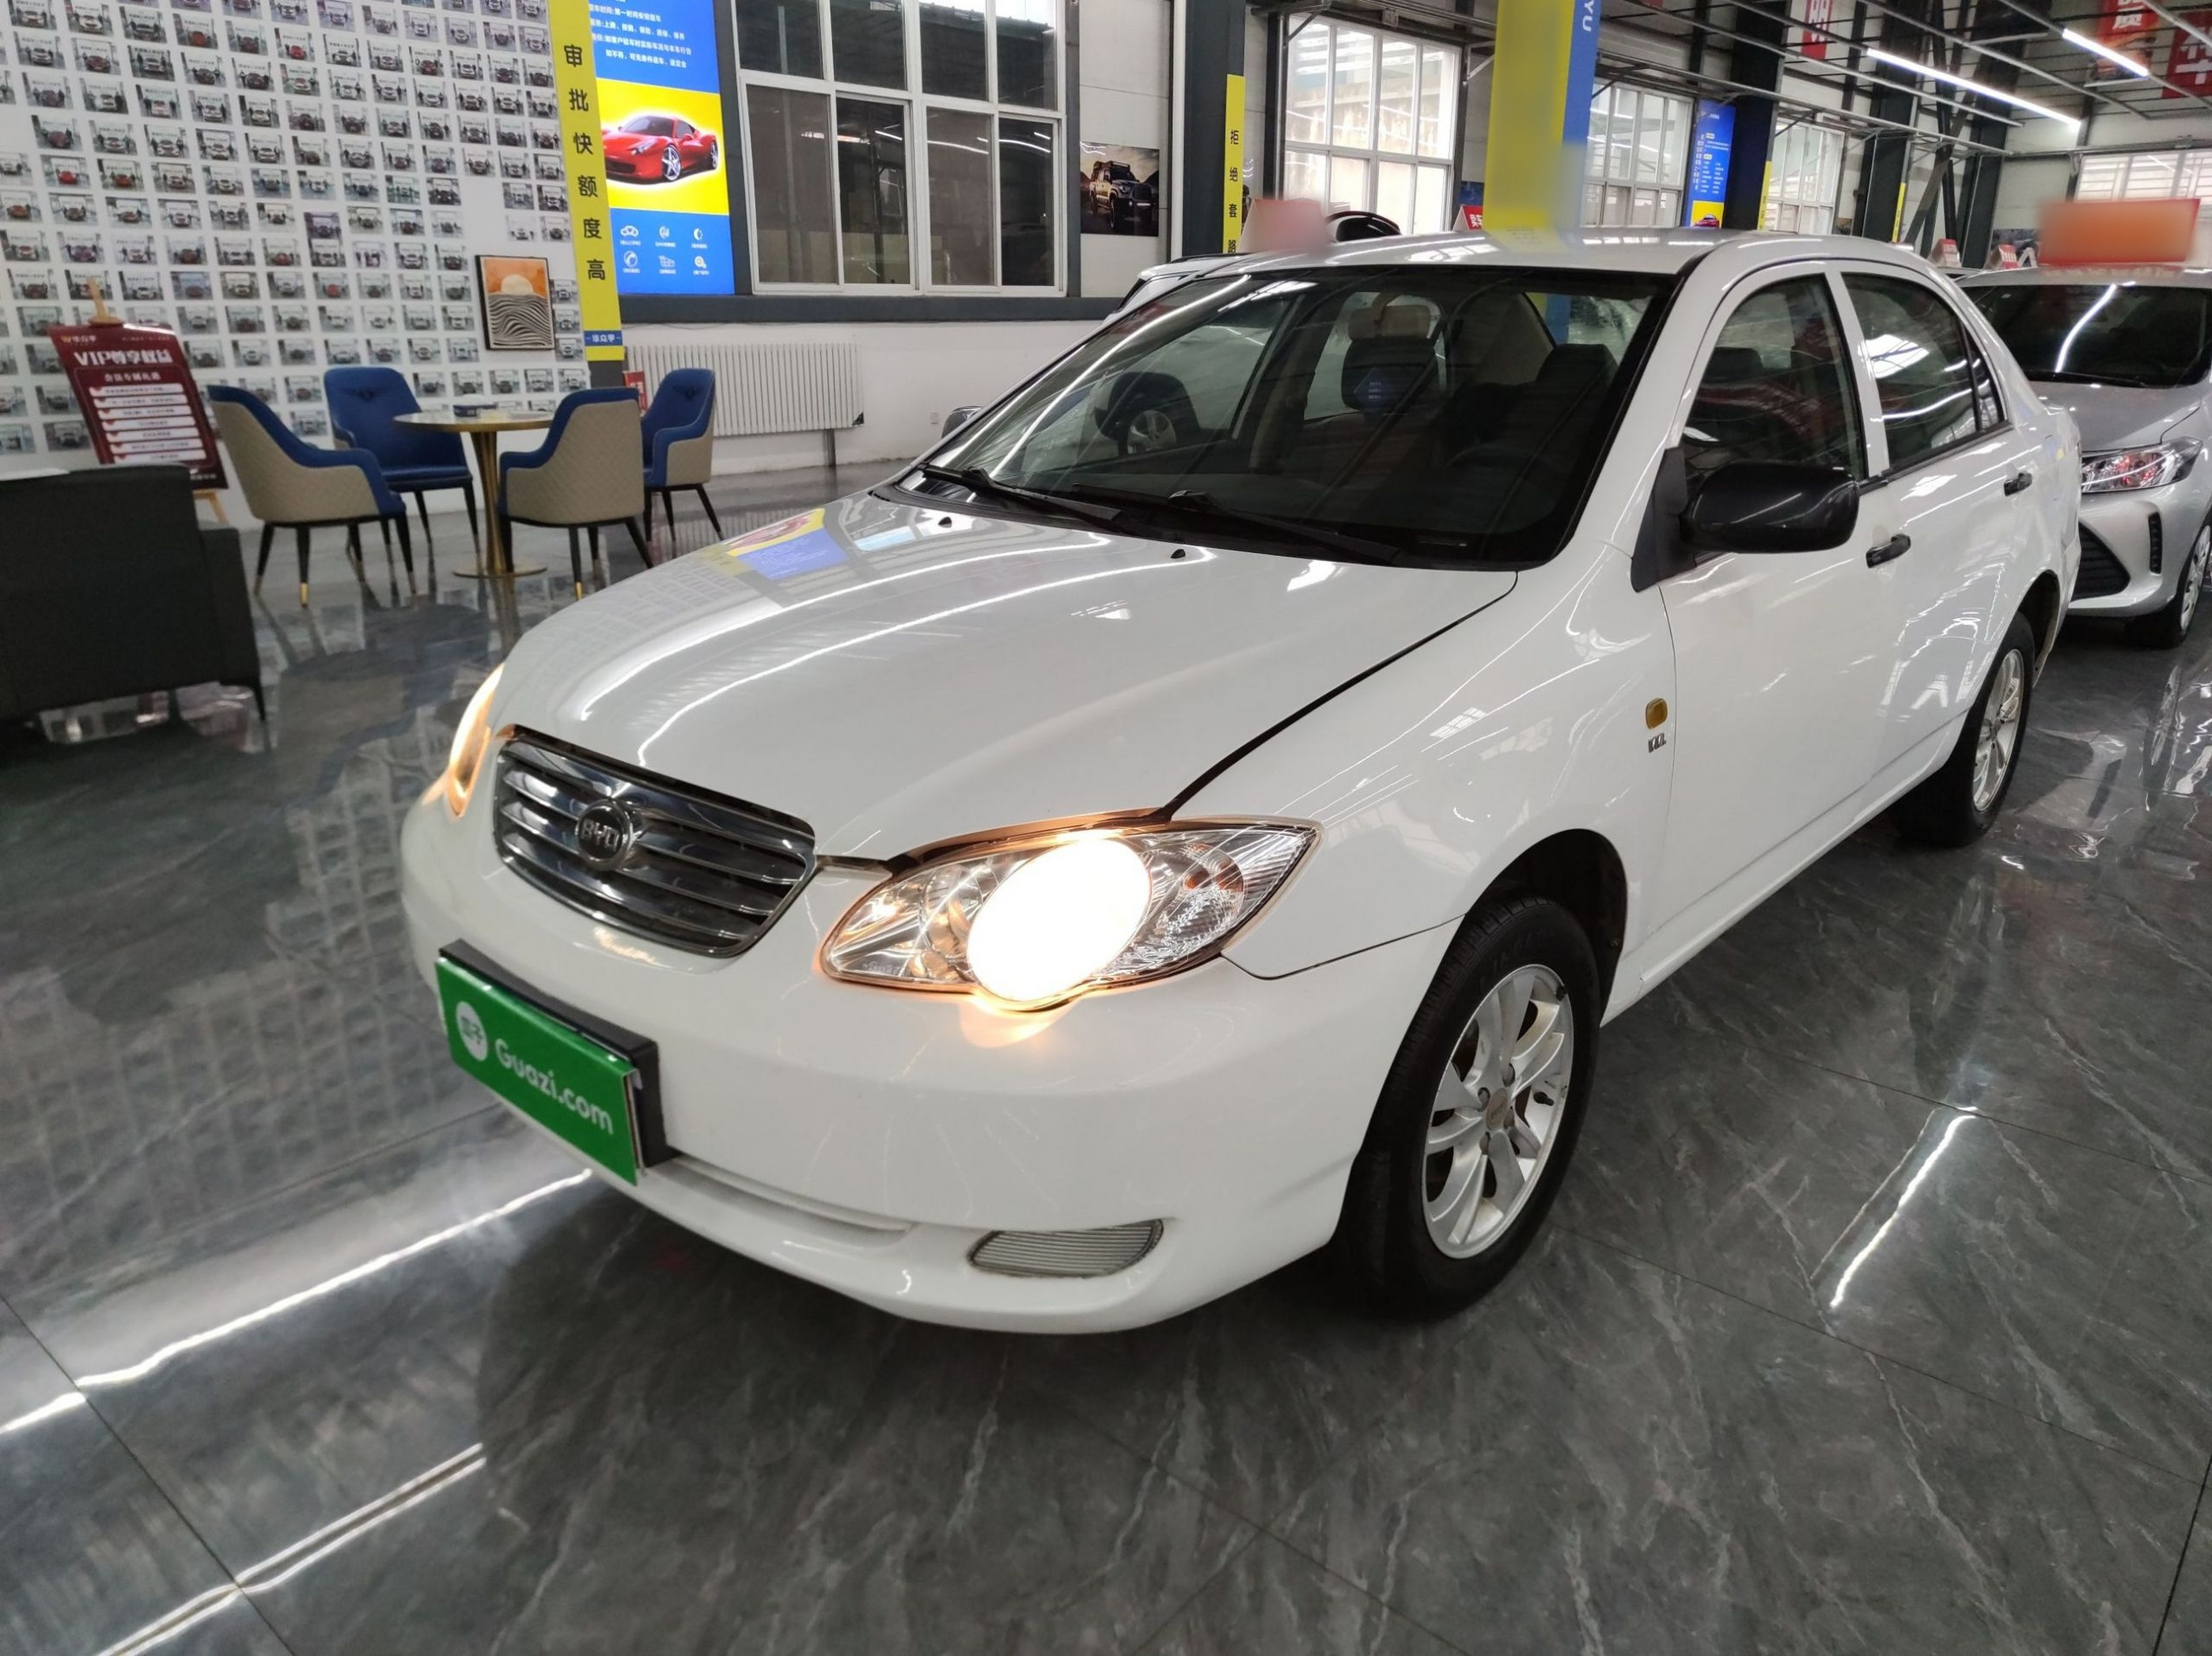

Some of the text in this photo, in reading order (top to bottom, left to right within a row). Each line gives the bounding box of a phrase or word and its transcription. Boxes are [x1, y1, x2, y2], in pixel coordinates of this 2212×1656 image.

[564, 44, 606, 281] 审批快额度高
[1228, 129, 1239, 253] 拒绝套路
[495, 1038, 613, 1135] Guazi.com
